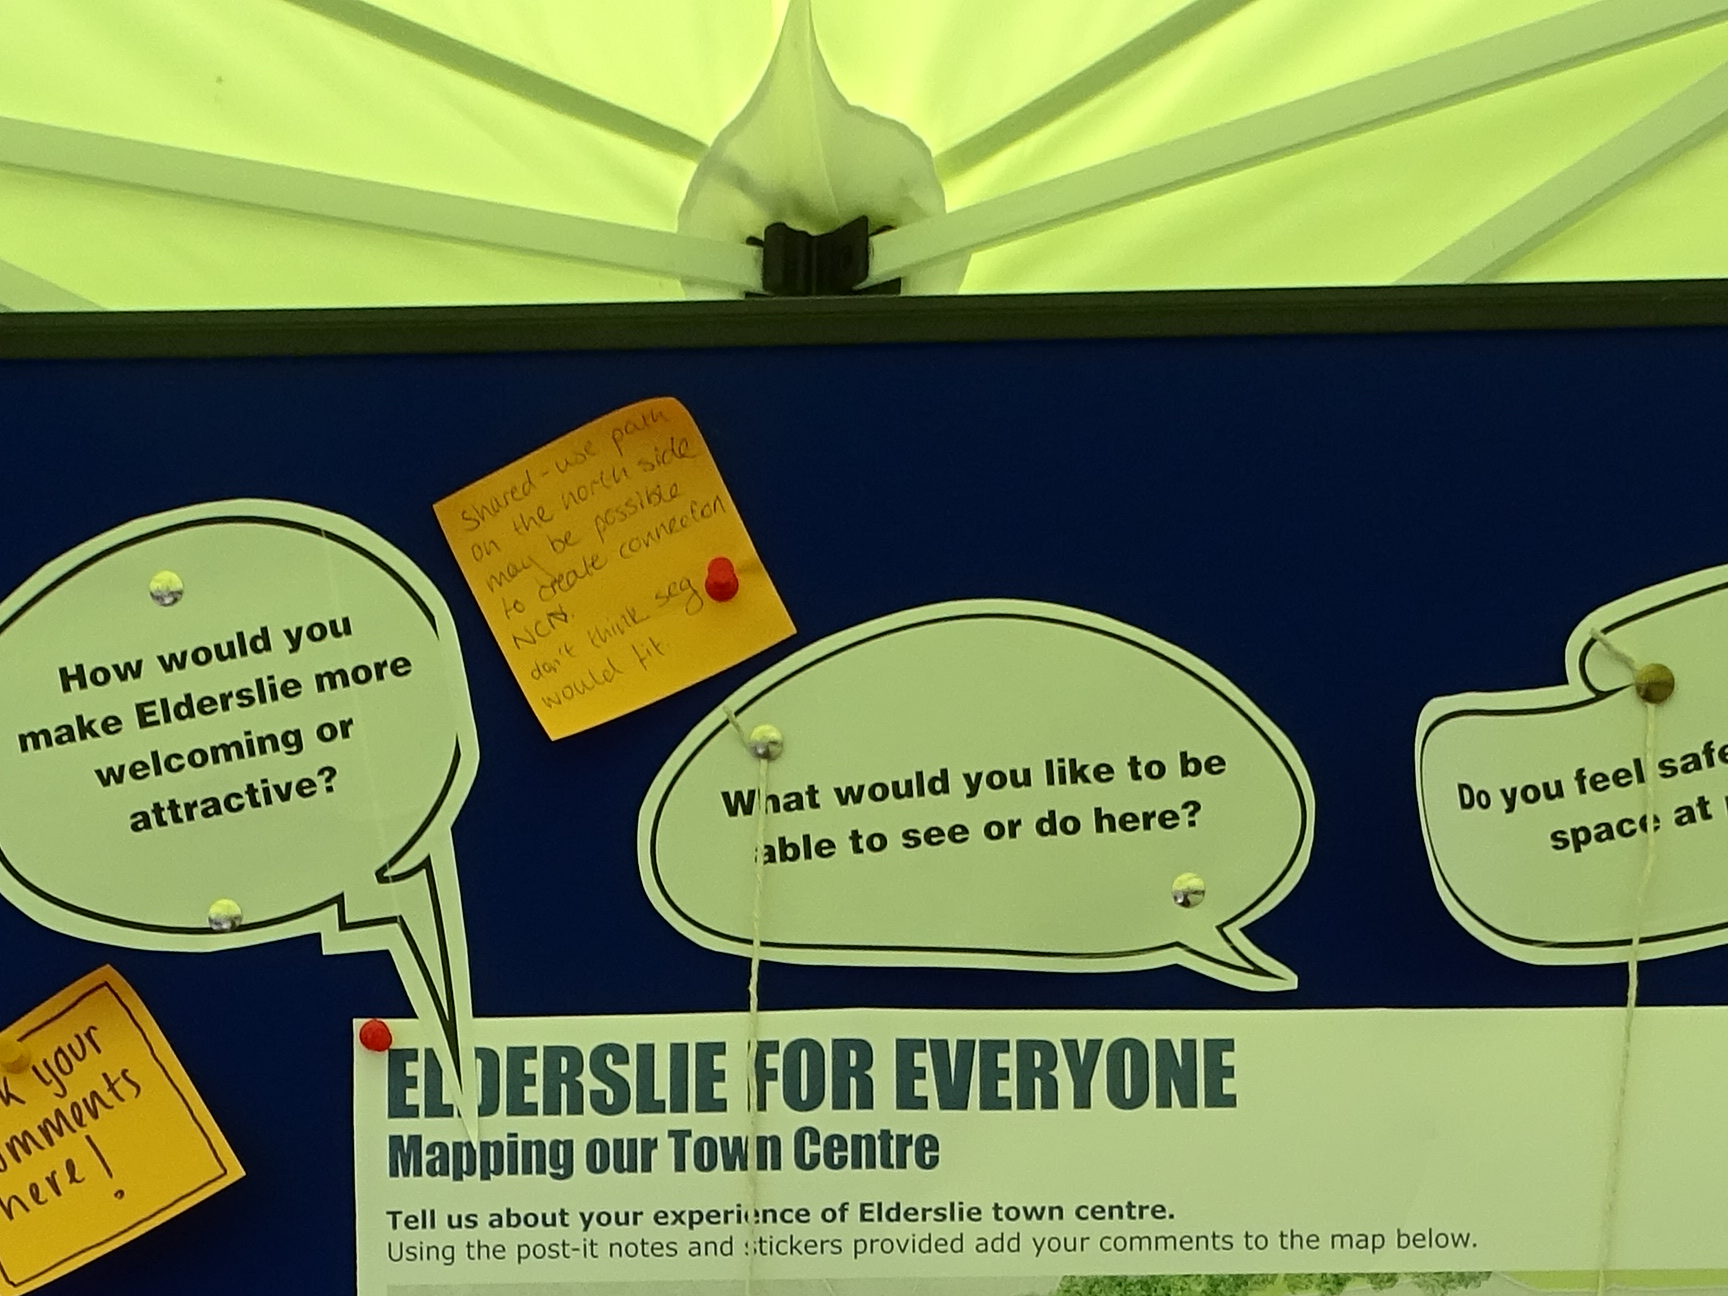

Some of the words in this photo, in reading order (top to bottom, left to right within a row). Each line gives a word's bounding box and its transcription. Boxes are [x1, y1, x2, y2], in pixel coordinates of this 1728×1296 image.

[58, 658, 144, 694] How
[156, 625, 272, 674] would
[282, 616, 353, 655] you
[17, 713, 123, 754] make
[134, 674, 303, 730] Elderslie
[314, 656, 412, 694] more
[94, 728, 304, 788] welcoming
[316, 717, 354, 743] or
[129, 765, 337, 833] attractive?
[32, 1025, 102, 1098] your
[387, 1042, 727, 1120] ELDERSLIE
[747, 1036, 875, 1114] FOR
[893, 1036, 1238, 1112] EVERYONE
[388, 1132, 574, 1182] Mapping
[585, 1136, 659, 1175] our
[667, 1128, 782, 1173] Town
[793, 1125, 936, 1172] Centre
